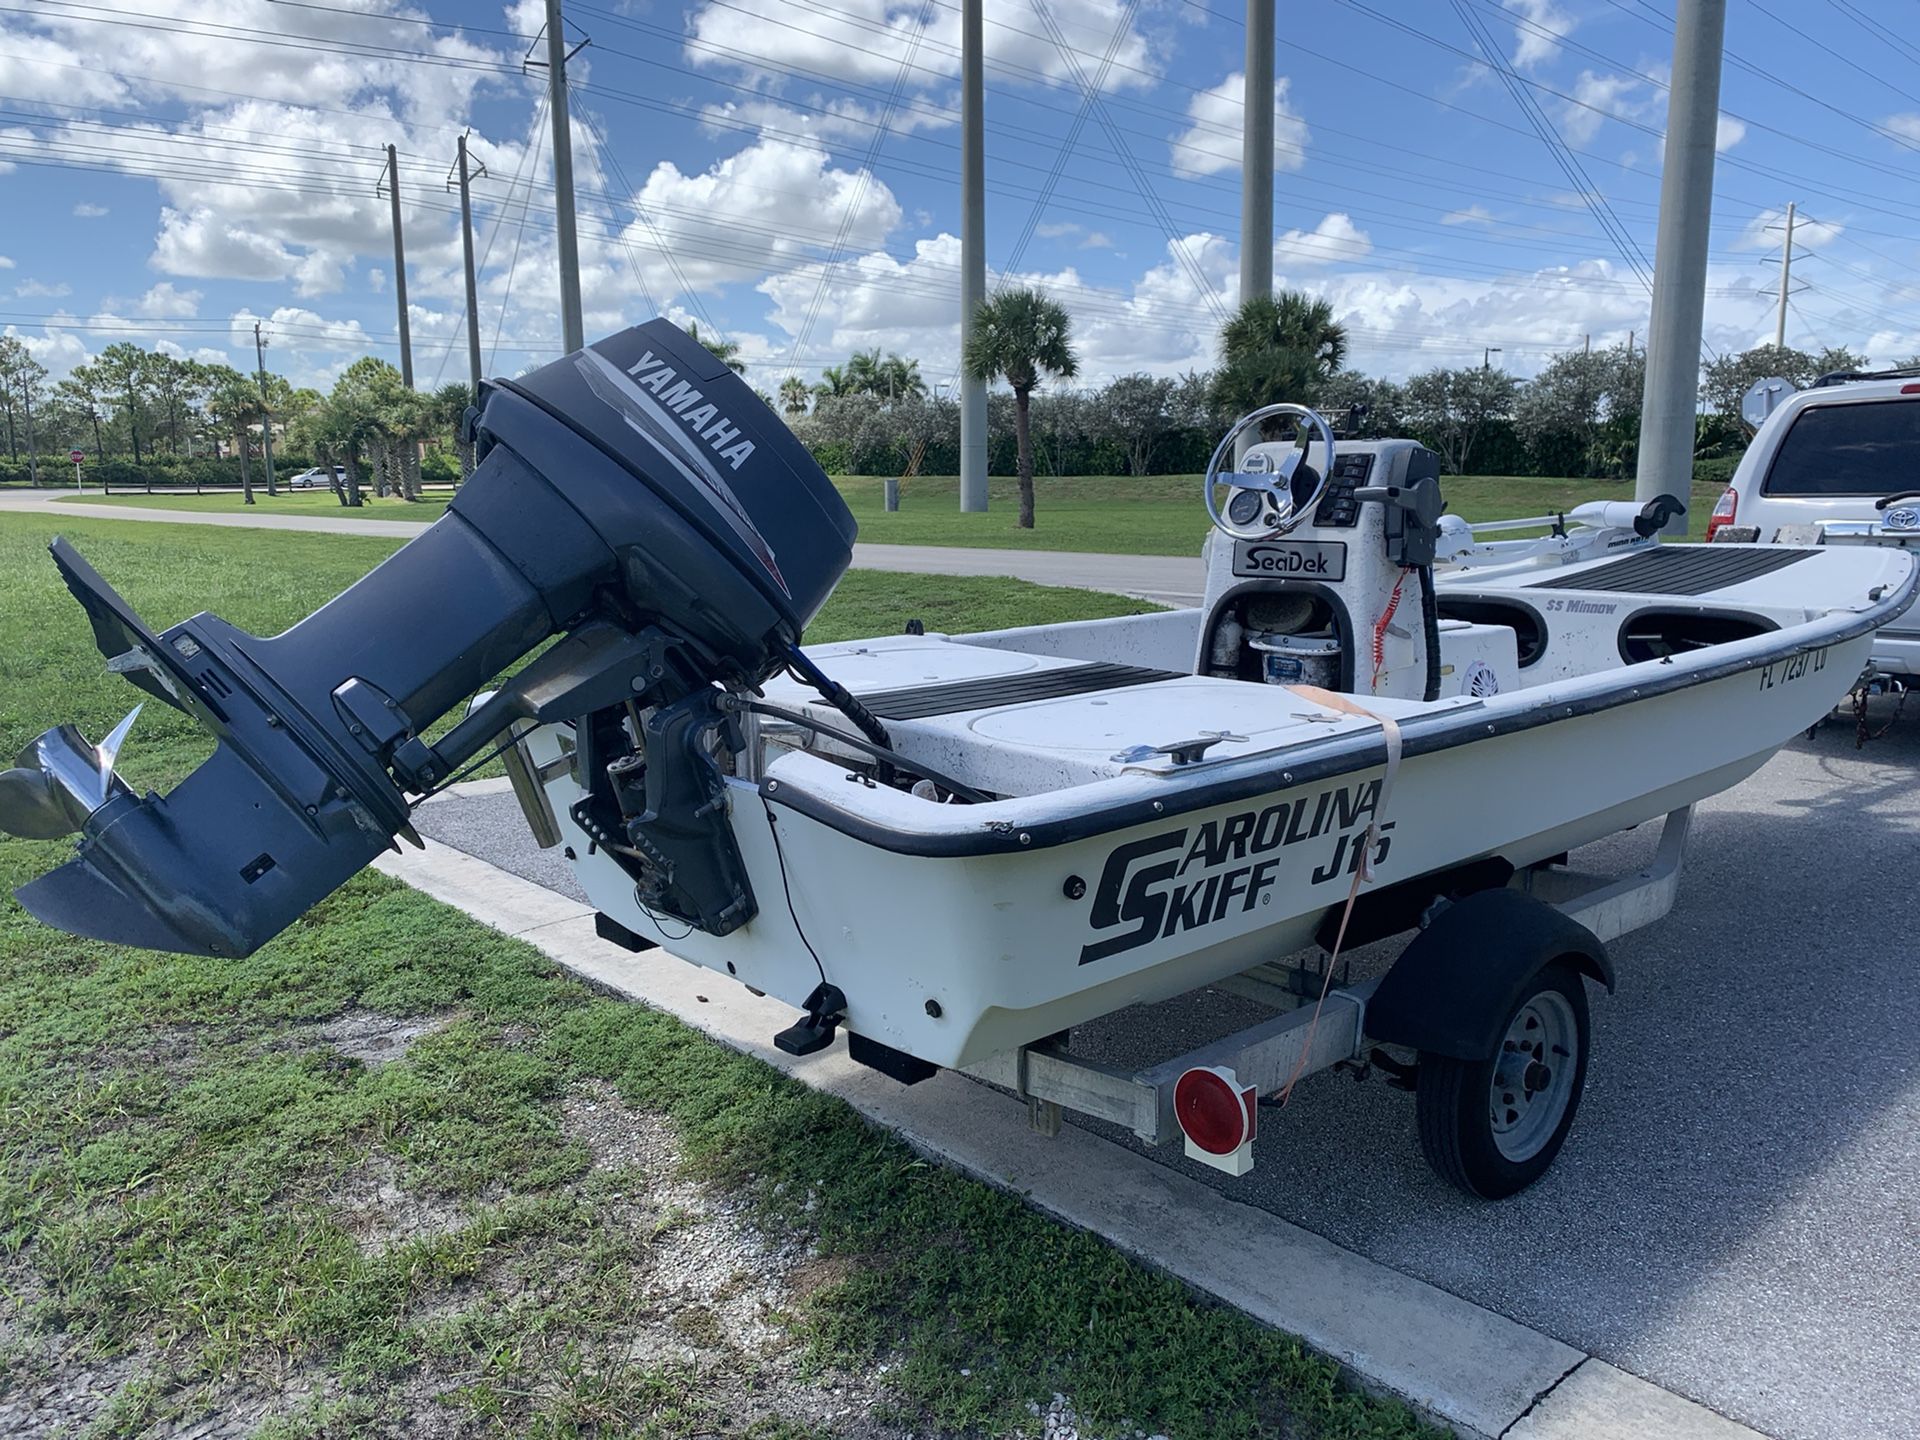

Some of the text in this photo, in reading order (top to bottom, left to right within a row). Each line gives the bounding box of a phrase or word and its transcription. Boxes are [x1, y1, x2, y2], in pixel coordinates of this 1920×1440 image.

[627, 350, 756, 471] YAMAHA
[1245, 546, 1329, 573] SeaDek
[1546, 599, 1617, 615] SS Minnow
[1089, 779, 1383, 930] CAROLINA
